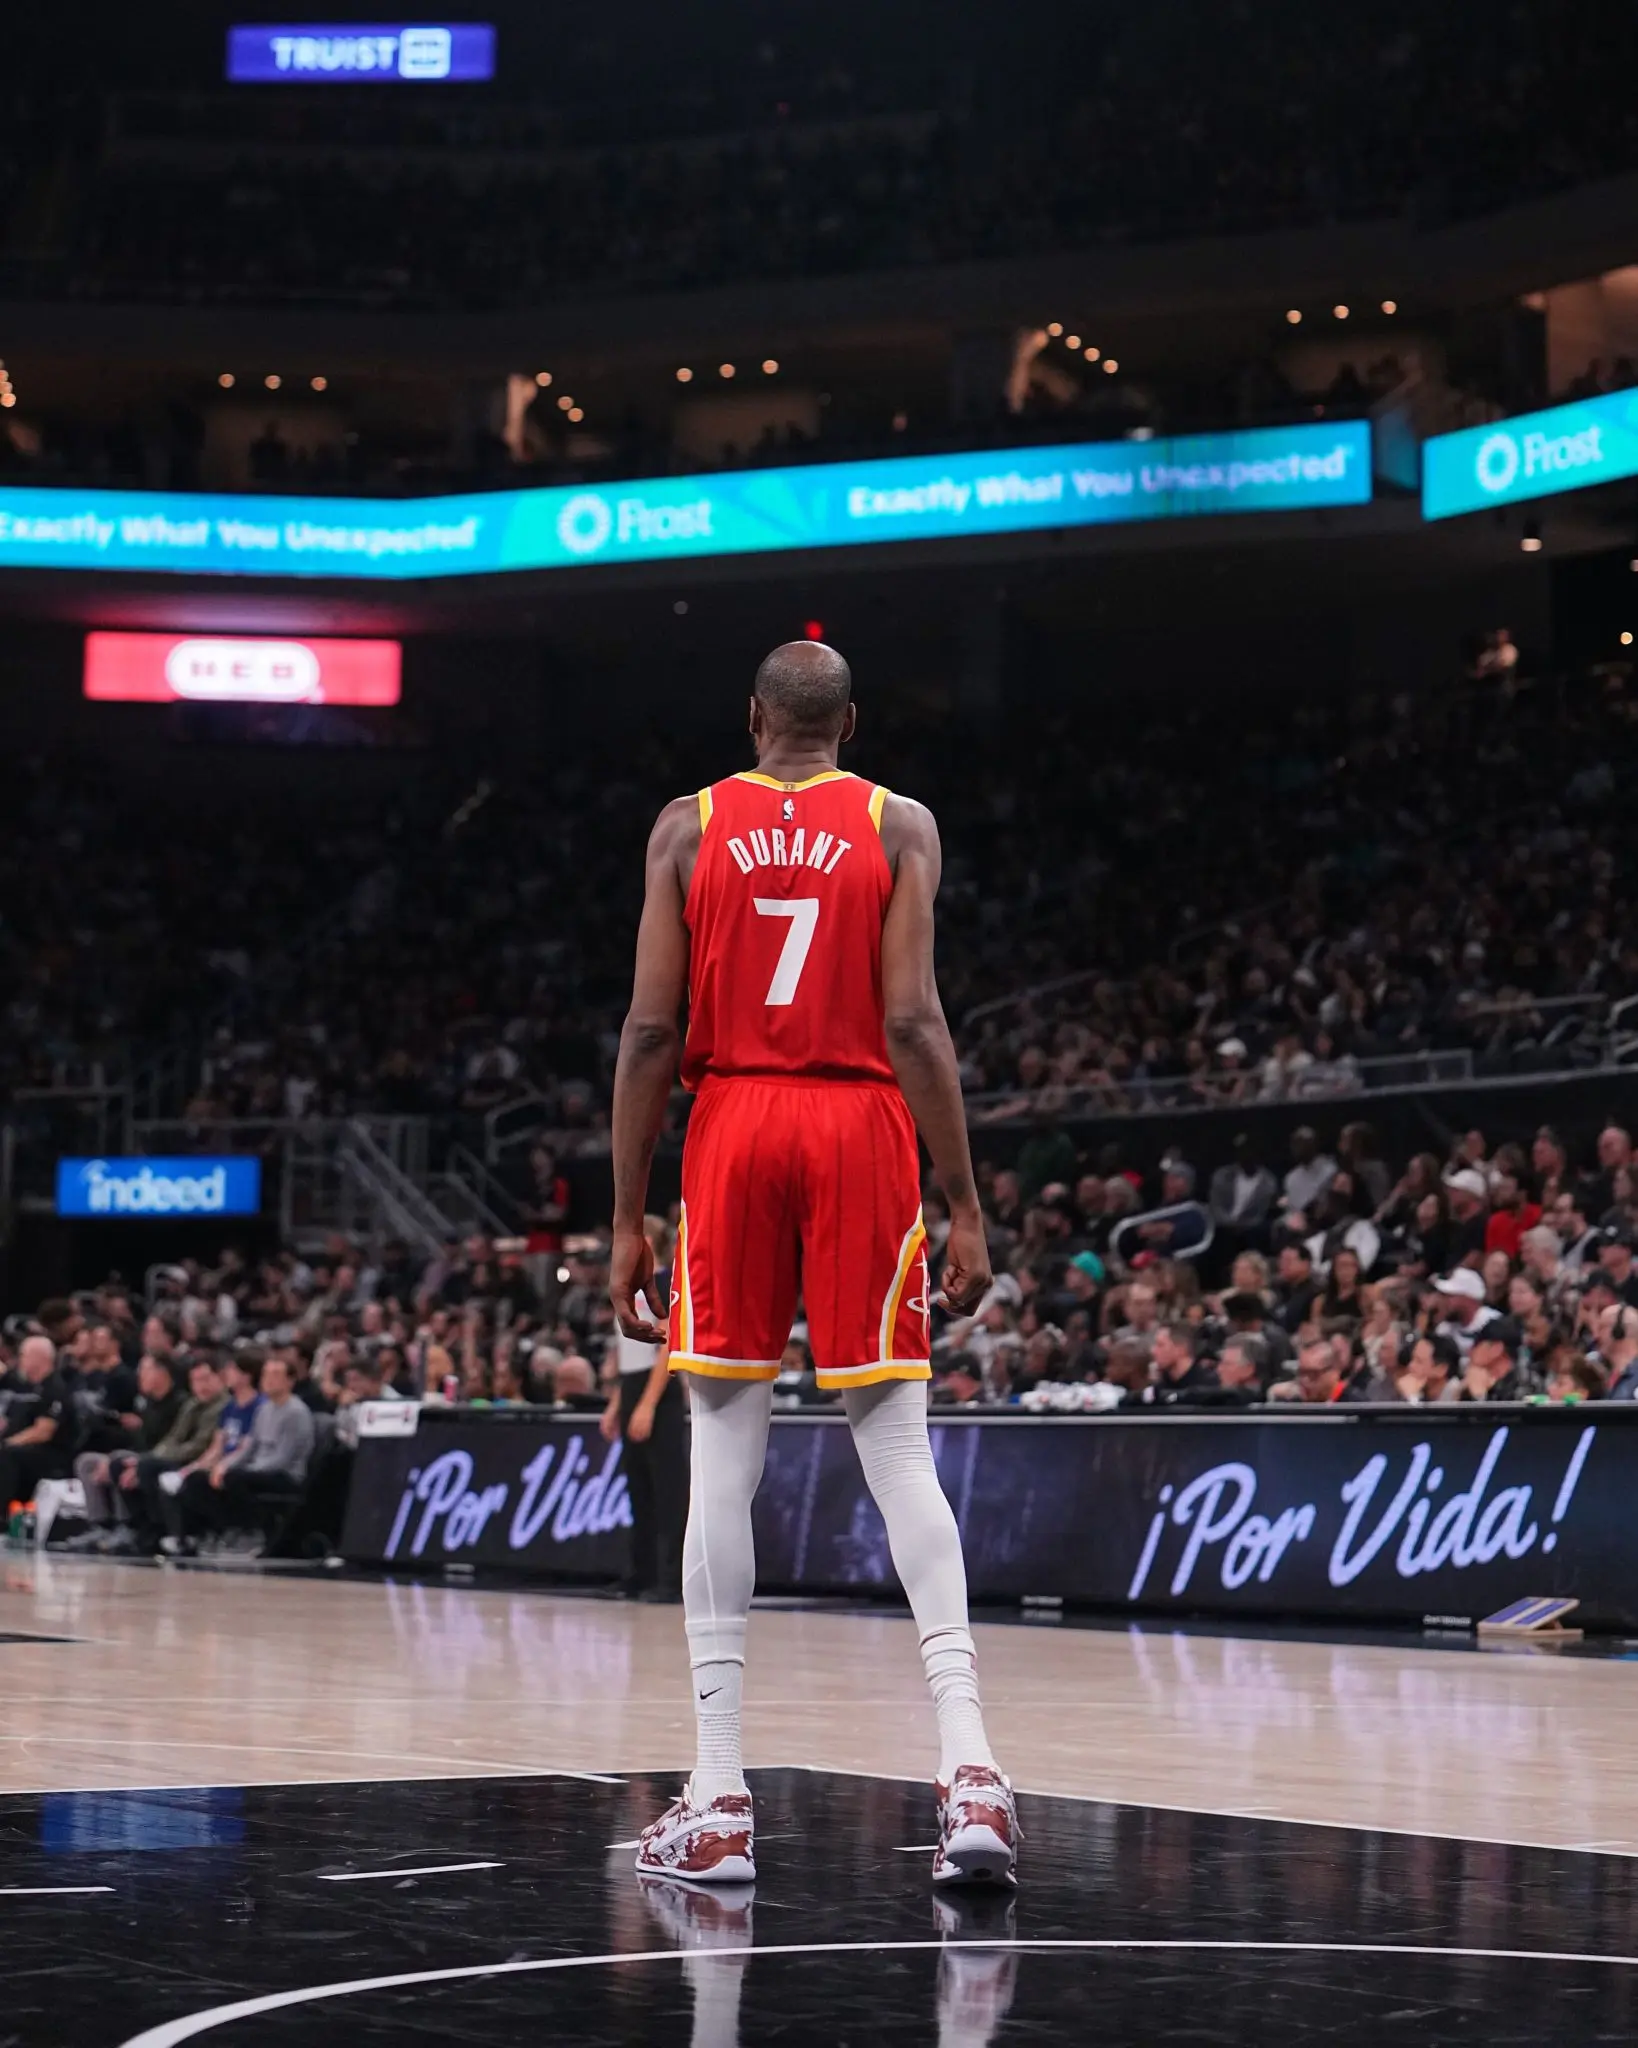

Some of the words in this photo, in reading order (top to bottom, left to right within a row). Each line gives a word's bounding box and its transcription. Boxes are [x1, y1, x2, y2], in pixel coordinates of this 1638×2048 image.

[270, 36, 398, 71] TRUIST
[1523, 424, 1603, 478] Frost
[848, 477, 971, 518] Exactly
[975, 471, 1063, 507] What
[1072, 468, 1134, 500] You
[1141, 445, 1348, 494] Unexpected
[0, 511, 115, 552] Exactly
[121, 513, 210, 549] What
[216, 517, 279, 551] You
[284, 515, 476, 560] Unexpected
[617, 498, 713, 543] Frost
[726, 828, 852, 875] DURANT
[753, 897, 819, 1006] 7
[82, 1159, 227, 1213] indeed
[1328, 1425, 1596, 1587] Vida!
